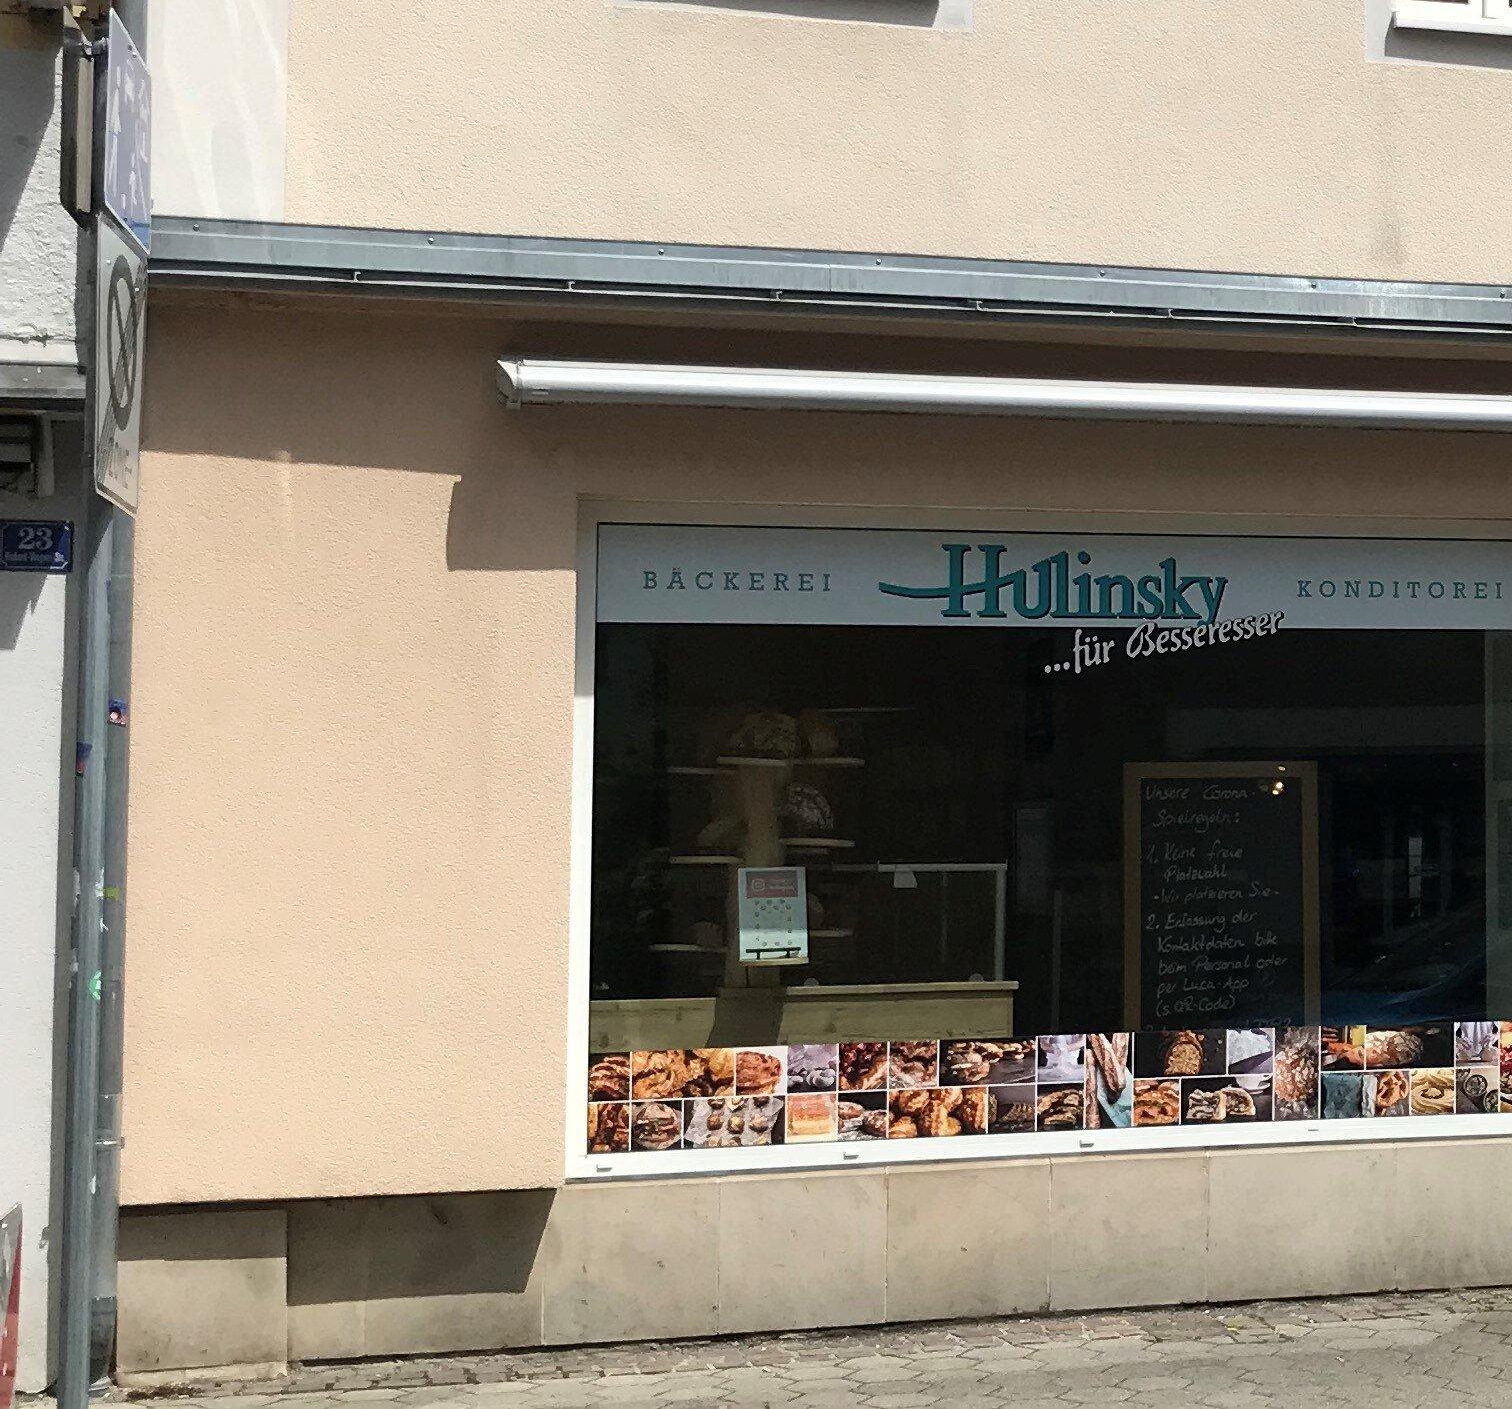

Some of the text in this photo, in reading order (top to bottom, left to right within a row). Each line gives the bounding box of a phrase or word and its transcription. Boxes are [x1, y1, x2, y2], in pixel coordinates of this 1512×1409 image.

[18, 527, 53, 550] 23
[642, 566, 832, 592] BÄCKEREI
[878, 543, 1229, 625] Hulinsky
[1296, 578, 1504, 600] KONDITOREI
[1126, 609, 1286, 658] Besseresser
